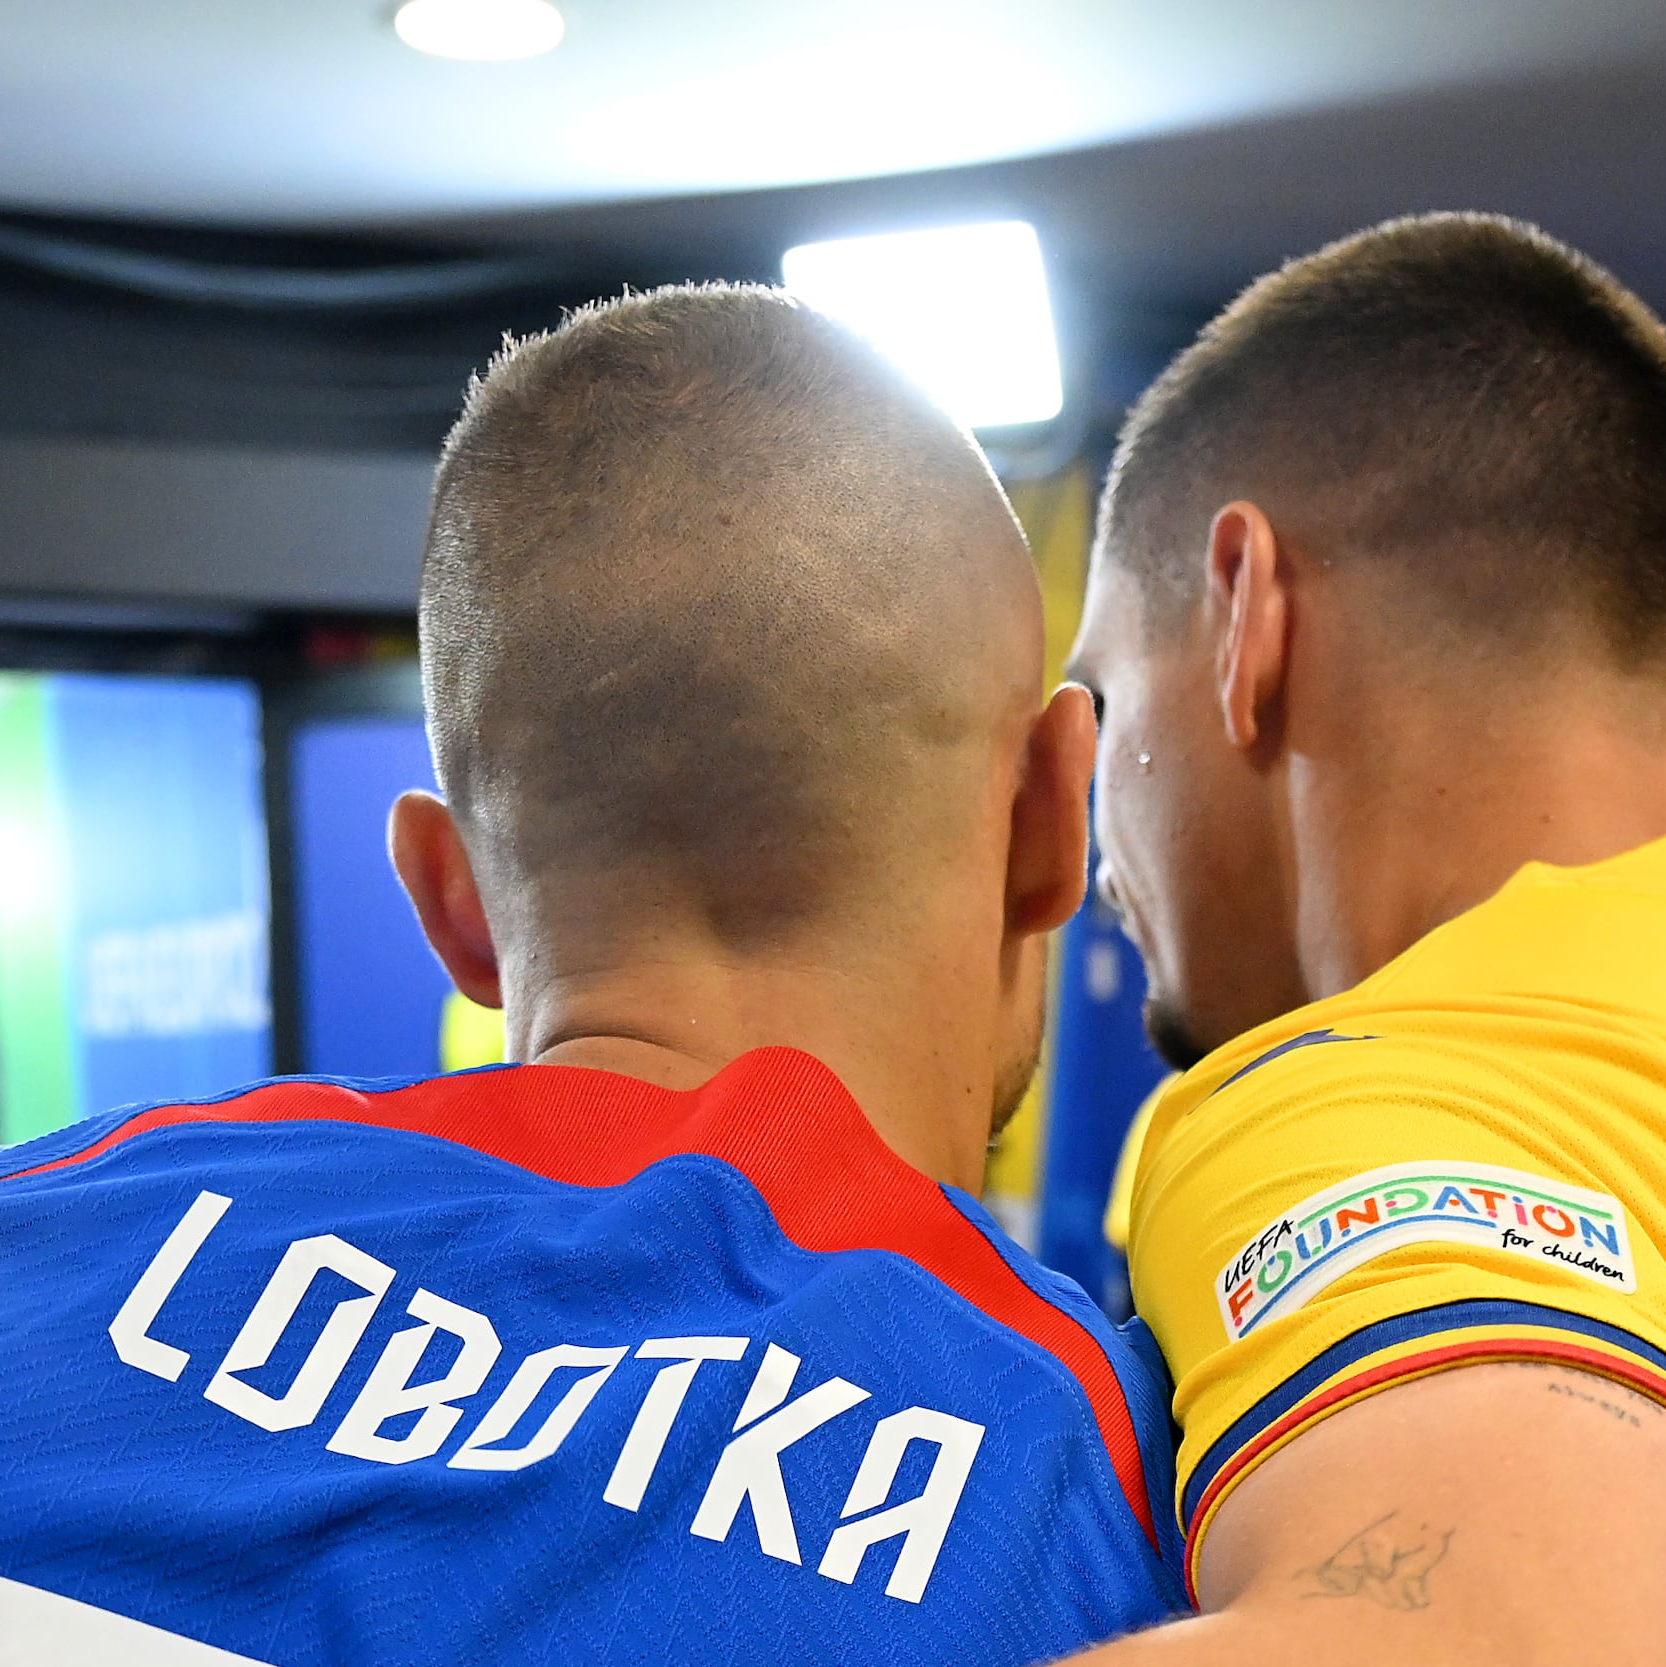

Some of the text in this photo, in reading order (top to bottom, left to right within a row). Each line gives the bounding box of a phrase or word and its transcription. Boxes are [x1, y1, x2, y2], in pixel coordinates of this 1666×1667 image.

[1223, 1219, 1295, 1293] UEFA
[1501, 1228, 1626, 1283] for children
[107, 1189, 986, 1604] LOBOTKA
